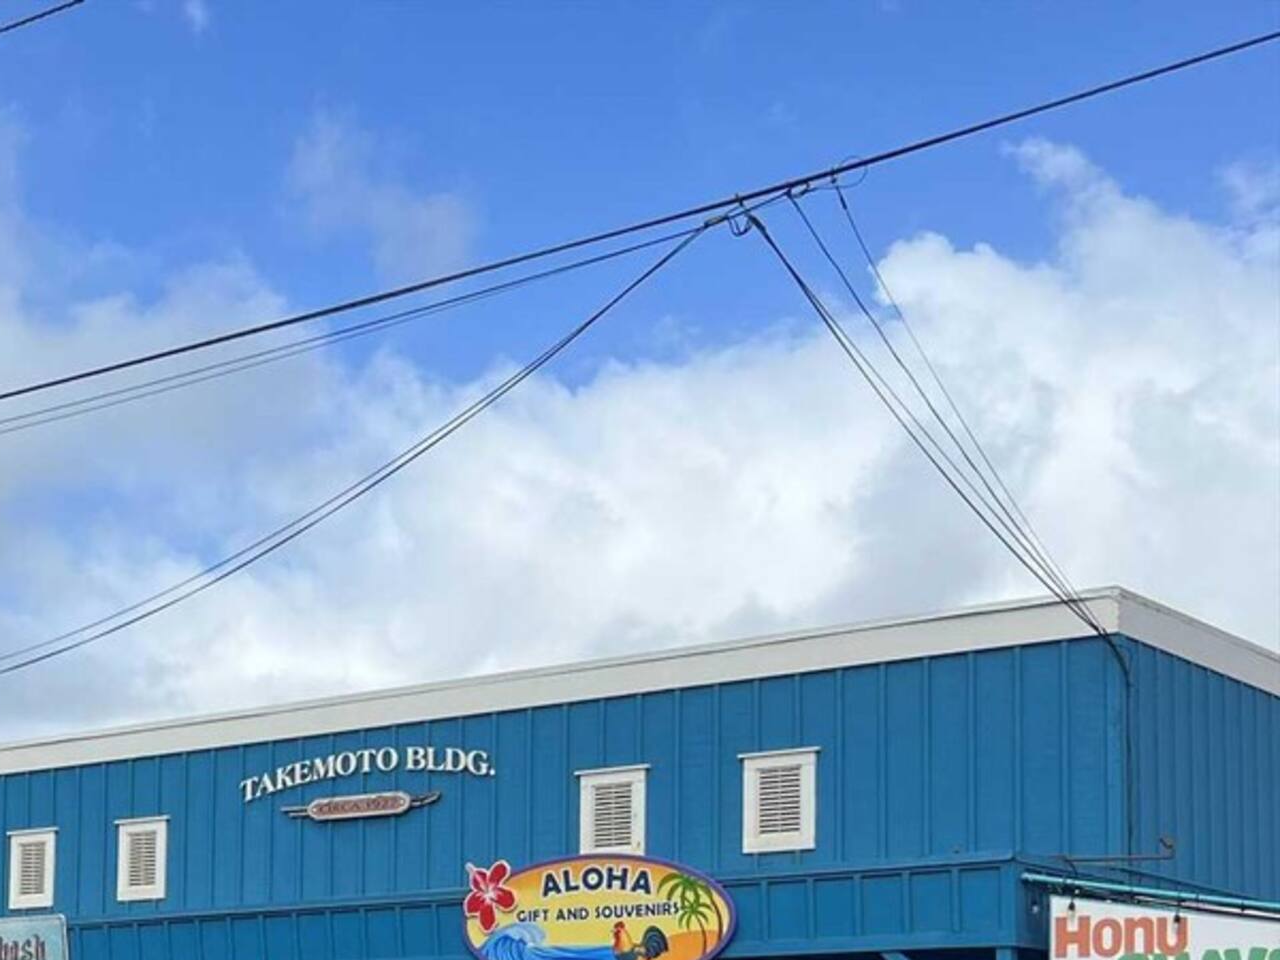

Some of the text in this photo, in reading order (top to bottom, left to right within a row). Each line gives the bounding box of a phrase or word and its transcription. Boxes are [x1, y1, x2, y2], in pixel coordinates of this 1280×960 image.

[240, 746, 496, 802] TAKEMOTO BLDG.
[319, 799, 361, 814] CIRCA
[542, 866, 652, 897] ALOHA
[517, 902, 680, 923] GIFT AND SOUVENIRS
